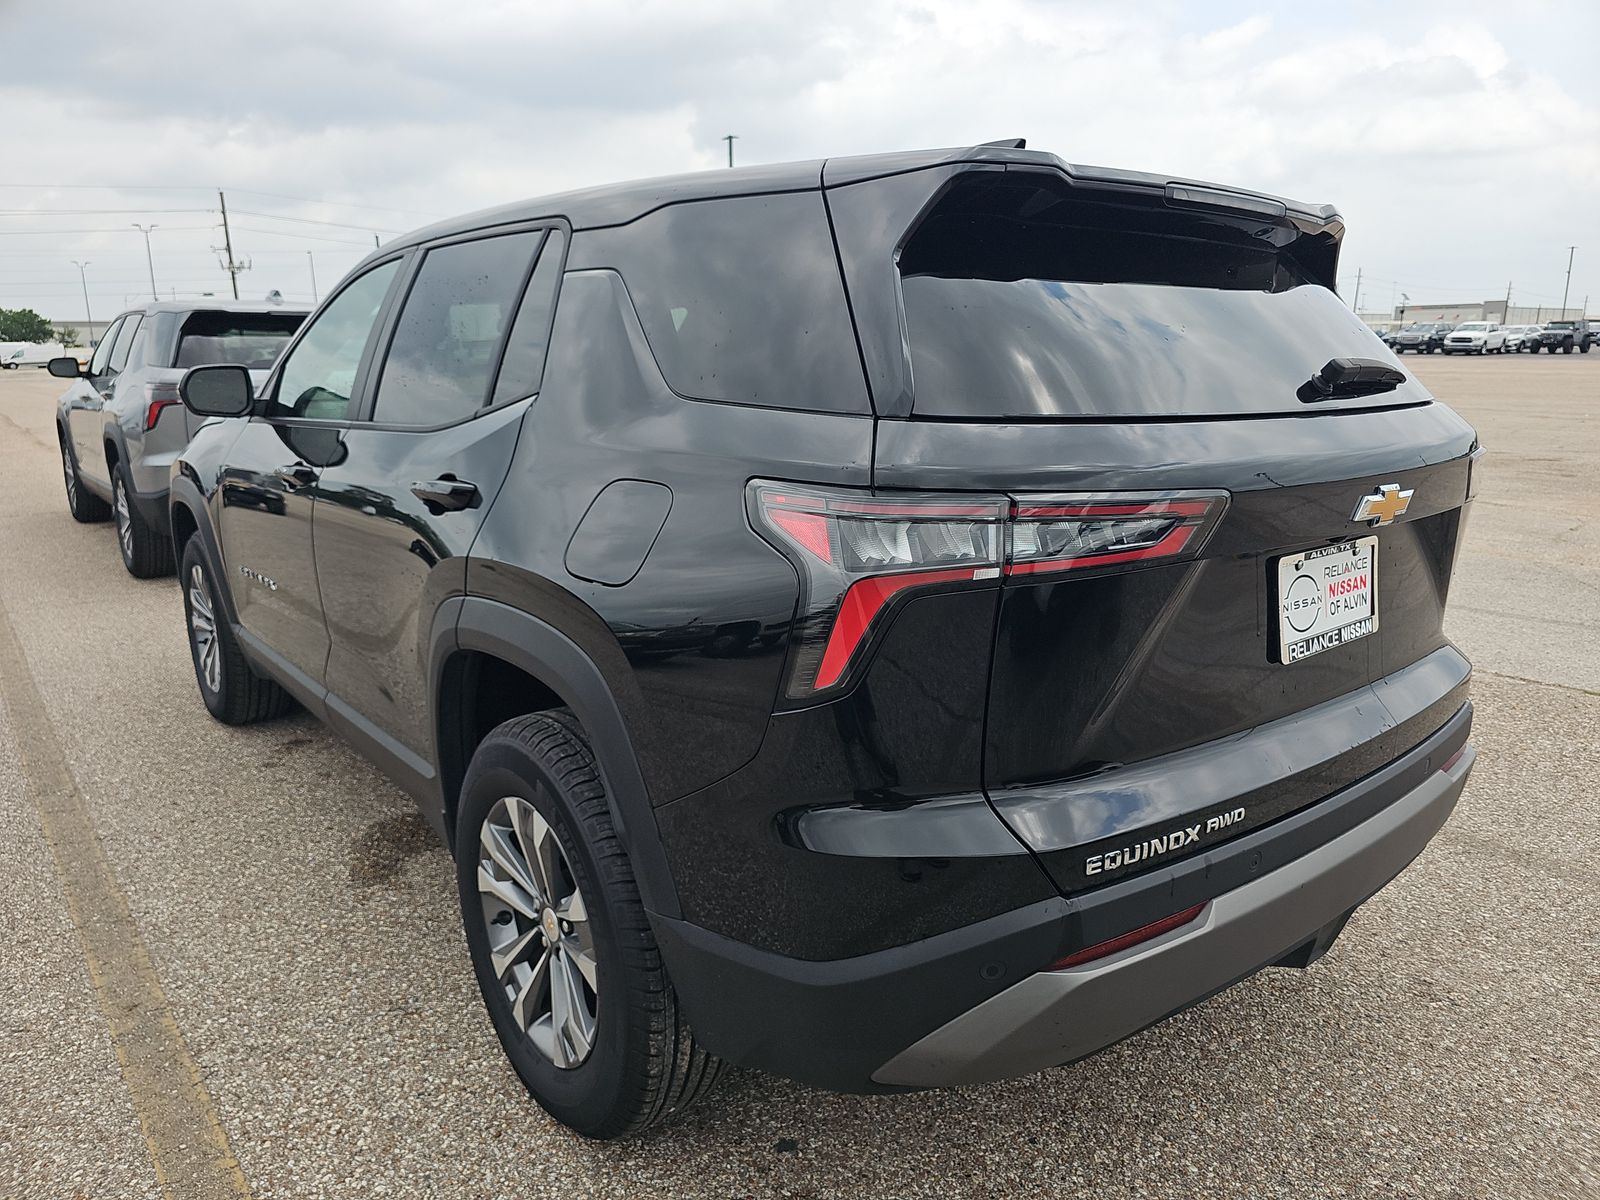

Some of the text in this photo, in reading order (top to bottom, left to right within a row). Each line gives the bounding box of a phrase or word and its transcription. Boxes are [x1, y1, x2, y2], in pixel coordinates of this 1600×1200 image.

[1340, 543, 1351, 552] TX
[1323, 557, 1368, 579] RELIANCE
[1328, 575, 1367, 598] NISSAN
[1282, 595, 1323, 613] NISSAN
[1329, 592, 1368, 616] OF ALVIN
[1288, 618, 1373, 661] RELIANCE NISSAN
[1085, 807, 1246, 876] EQUINOX AWD
